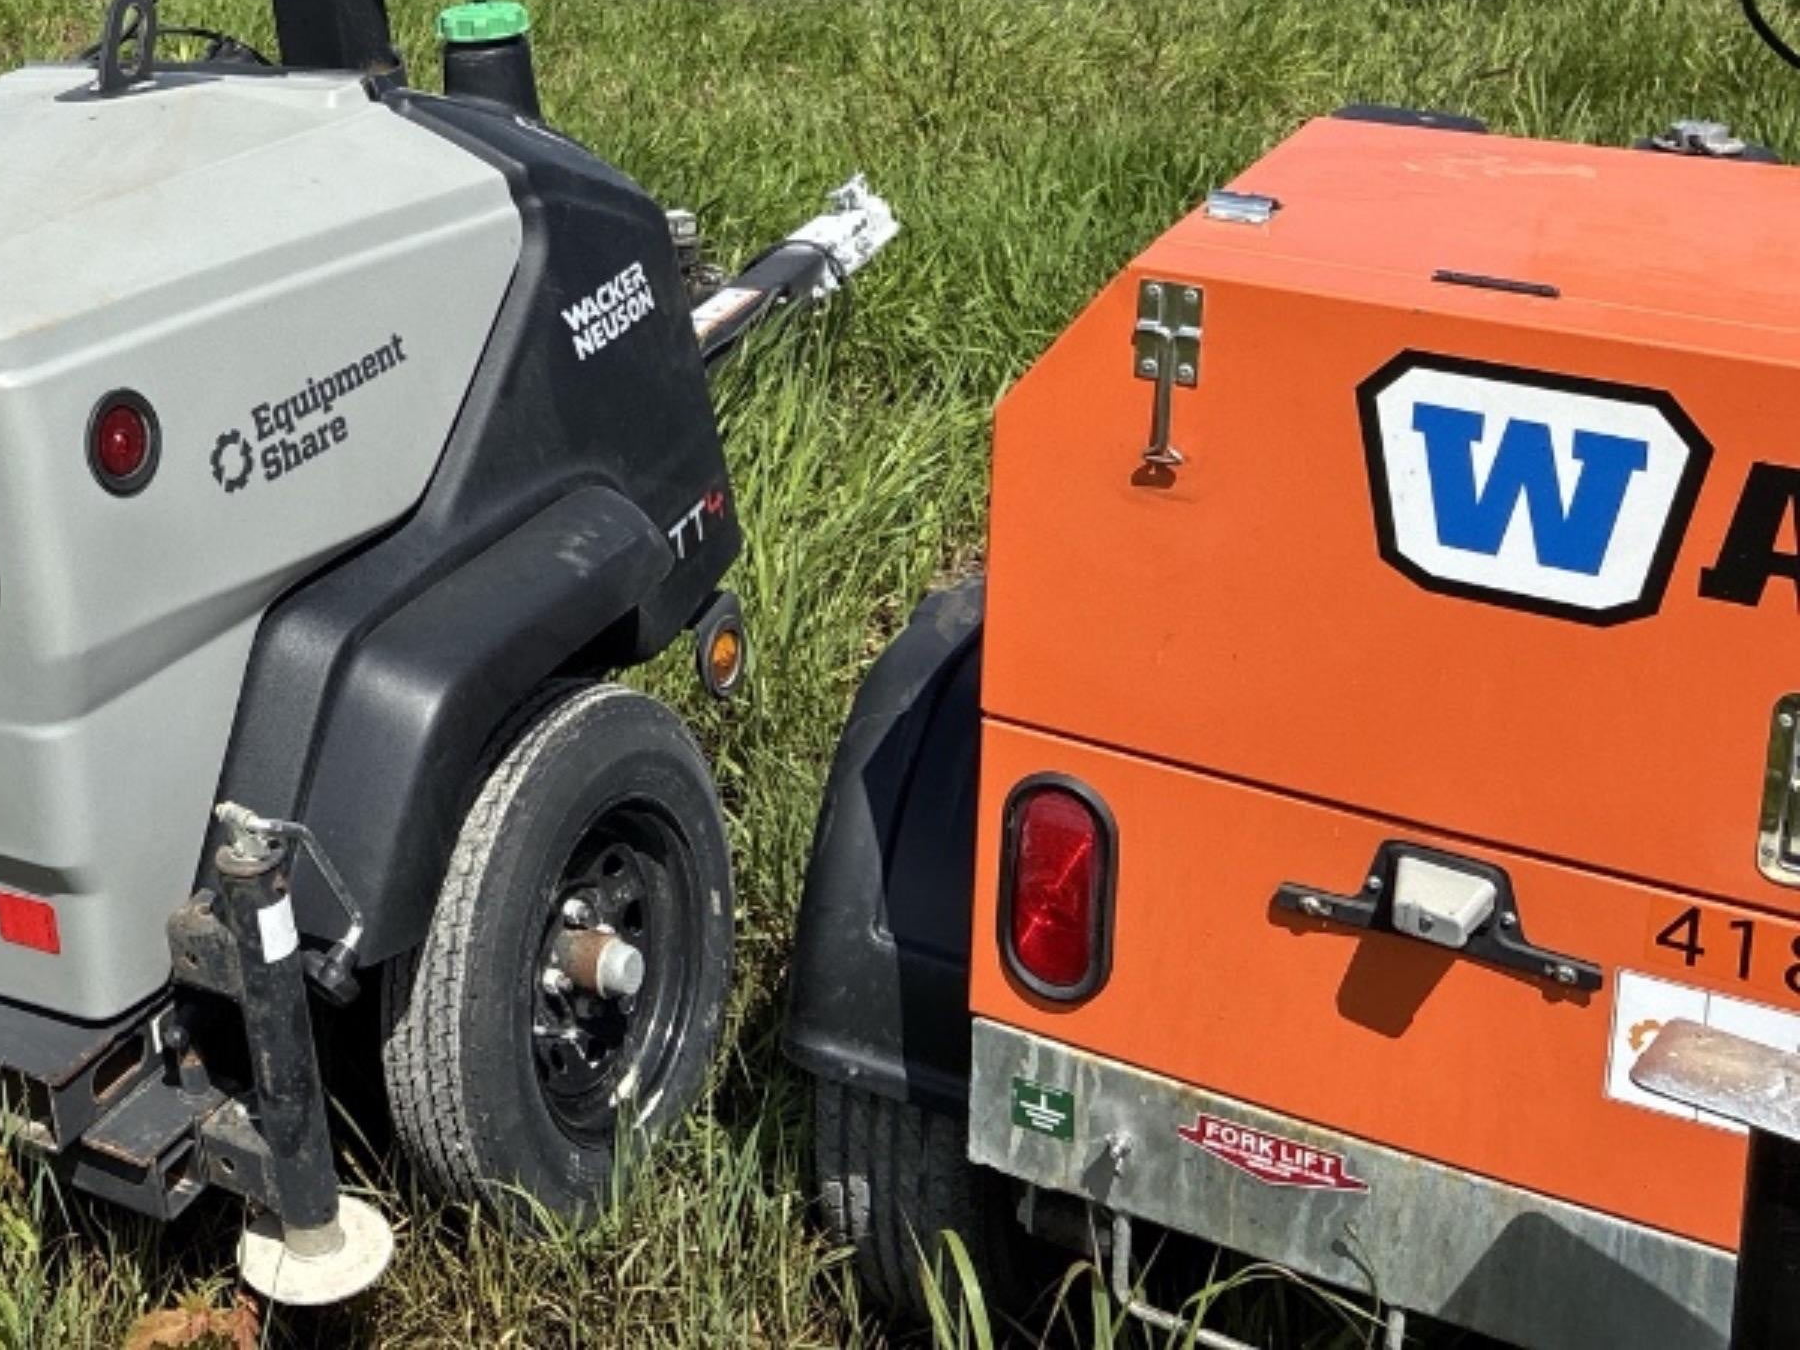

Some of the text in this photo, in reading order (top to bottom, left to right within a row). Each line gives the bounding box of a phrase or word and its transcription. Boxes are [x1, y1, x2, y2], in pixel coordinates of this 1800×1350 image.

[560, 261, 648, 331] WACKER
[572, 284, 655, 361] NEUSON
[251, 332, 407, 441] Equipment
[260, 415, 348, 481] Share
[1205, 1121, 1274, 1157] FORK
[1281, 1144, 1335, 1175] LIFT
